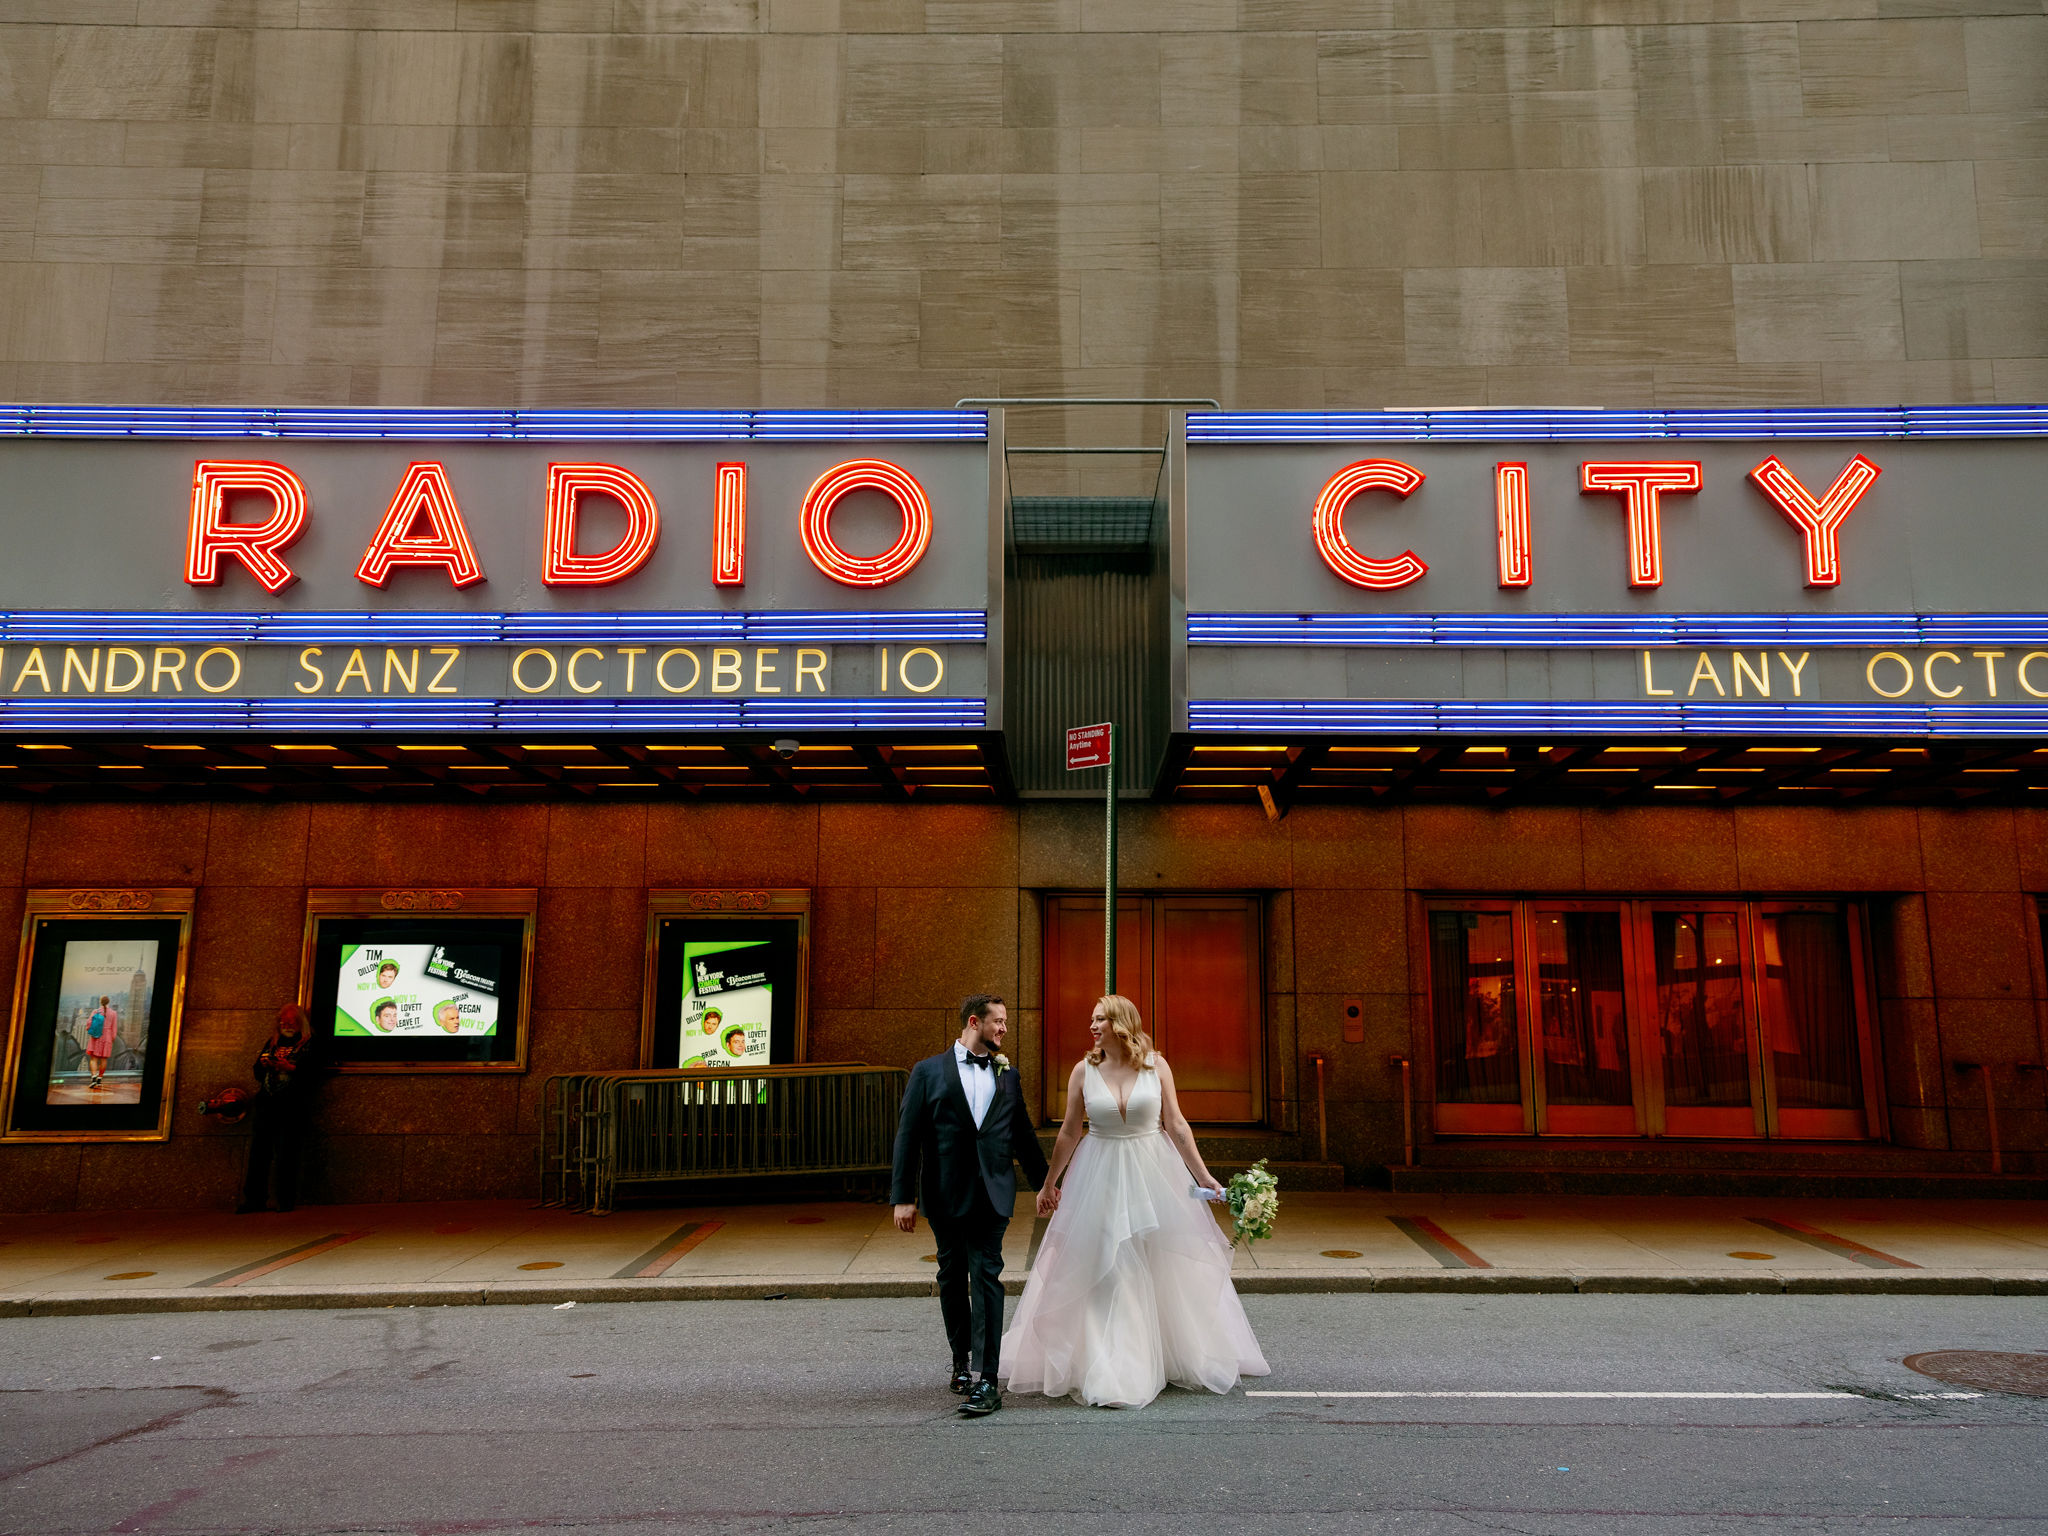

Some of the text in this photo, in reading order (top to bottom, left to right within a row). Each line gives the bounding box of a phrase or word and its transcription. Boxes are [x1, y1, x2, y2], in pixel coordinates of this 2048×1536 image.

[184, 458, 934, 595] RADIO
[1313, 453, 1883, 592] CITY
[0, 647, 241, 693] ANDRO
[294, 648, 461, 693] SANZ
[512, 647, 829, 693] OCTOBER
[1643, 650, 1811, 697] LANY
[1077, 728, 1104, 740] STANDING
[1069, 741, 1092, 750] Anytime
[366, 949, 383, 960] TIM
[358, 962, 378, 976] DILLON
[698, 971, 724, 982] NEW YORK
[699, 984, 723, 994] FESTIVAL
[410, 994, 417, 1002] 12
[453, 993, 469, 1003] BRIAN
[401, 1003, 422, 1012] LOVETT
[459, 1004, 482, 1014] REGAN
[692, 1001, 706, 1010] TIM
[397, 1018, 413, 1028] LEAVE
[414, 1017, 420, 1025] IT
[686, 1012, 704, 1024] DILLON
[459, 1018, 485, 1030] NOV 13
[748, 1030, 767, 1038] LOVETT
[702, 1049, 718, 1058] BRIAN
[745, 1044, 760, 1053] LEAVE
